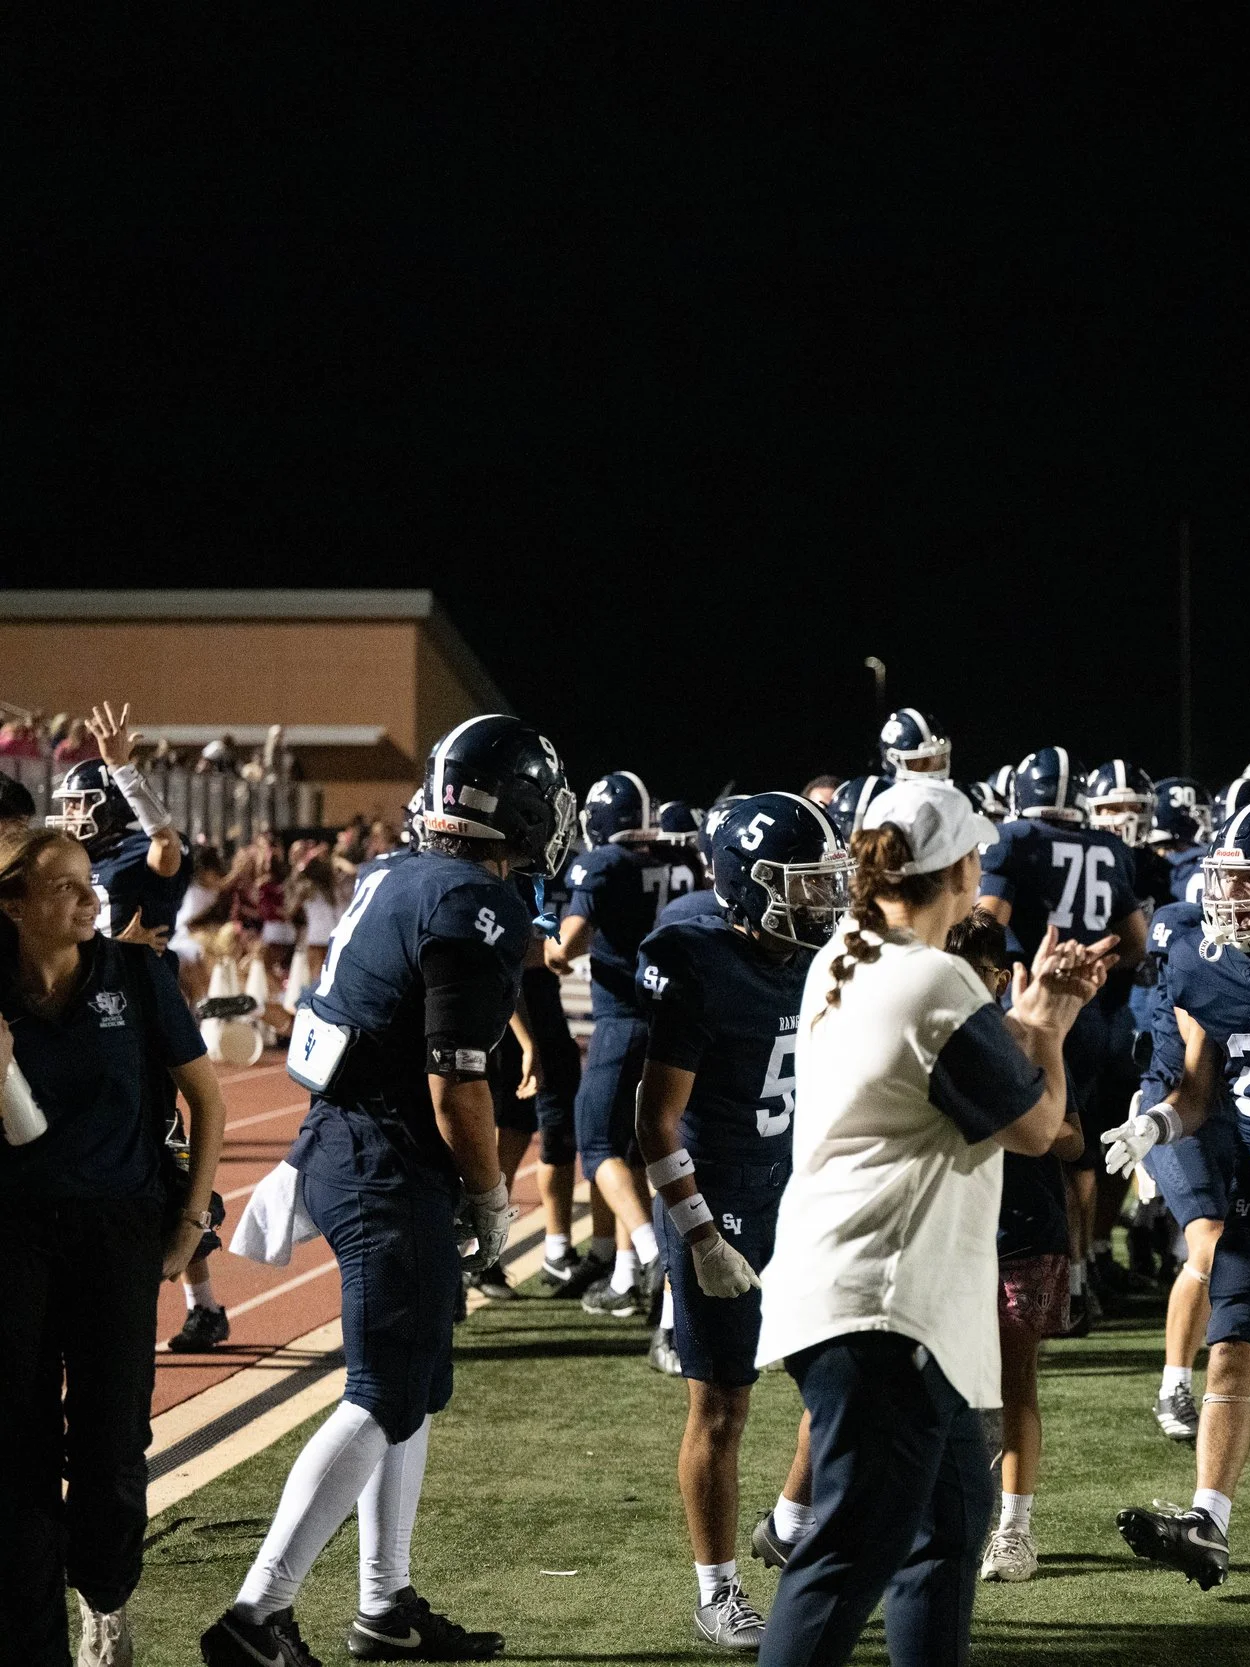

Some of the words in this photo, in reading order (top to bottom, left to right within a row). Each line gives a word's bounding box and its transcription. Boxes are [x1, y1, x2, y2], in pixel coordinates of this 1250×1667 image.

[538, 735, 560, 773] 9
[740, 812, 776, 851] 5
[1048, 841, 1116, 931] 76
[474, 907, 505, 946] SV
[1152, 922, 1173, 948] SV
[643, 965, 669, 1000] SV
[722, 1213, 742, 1235] SV
